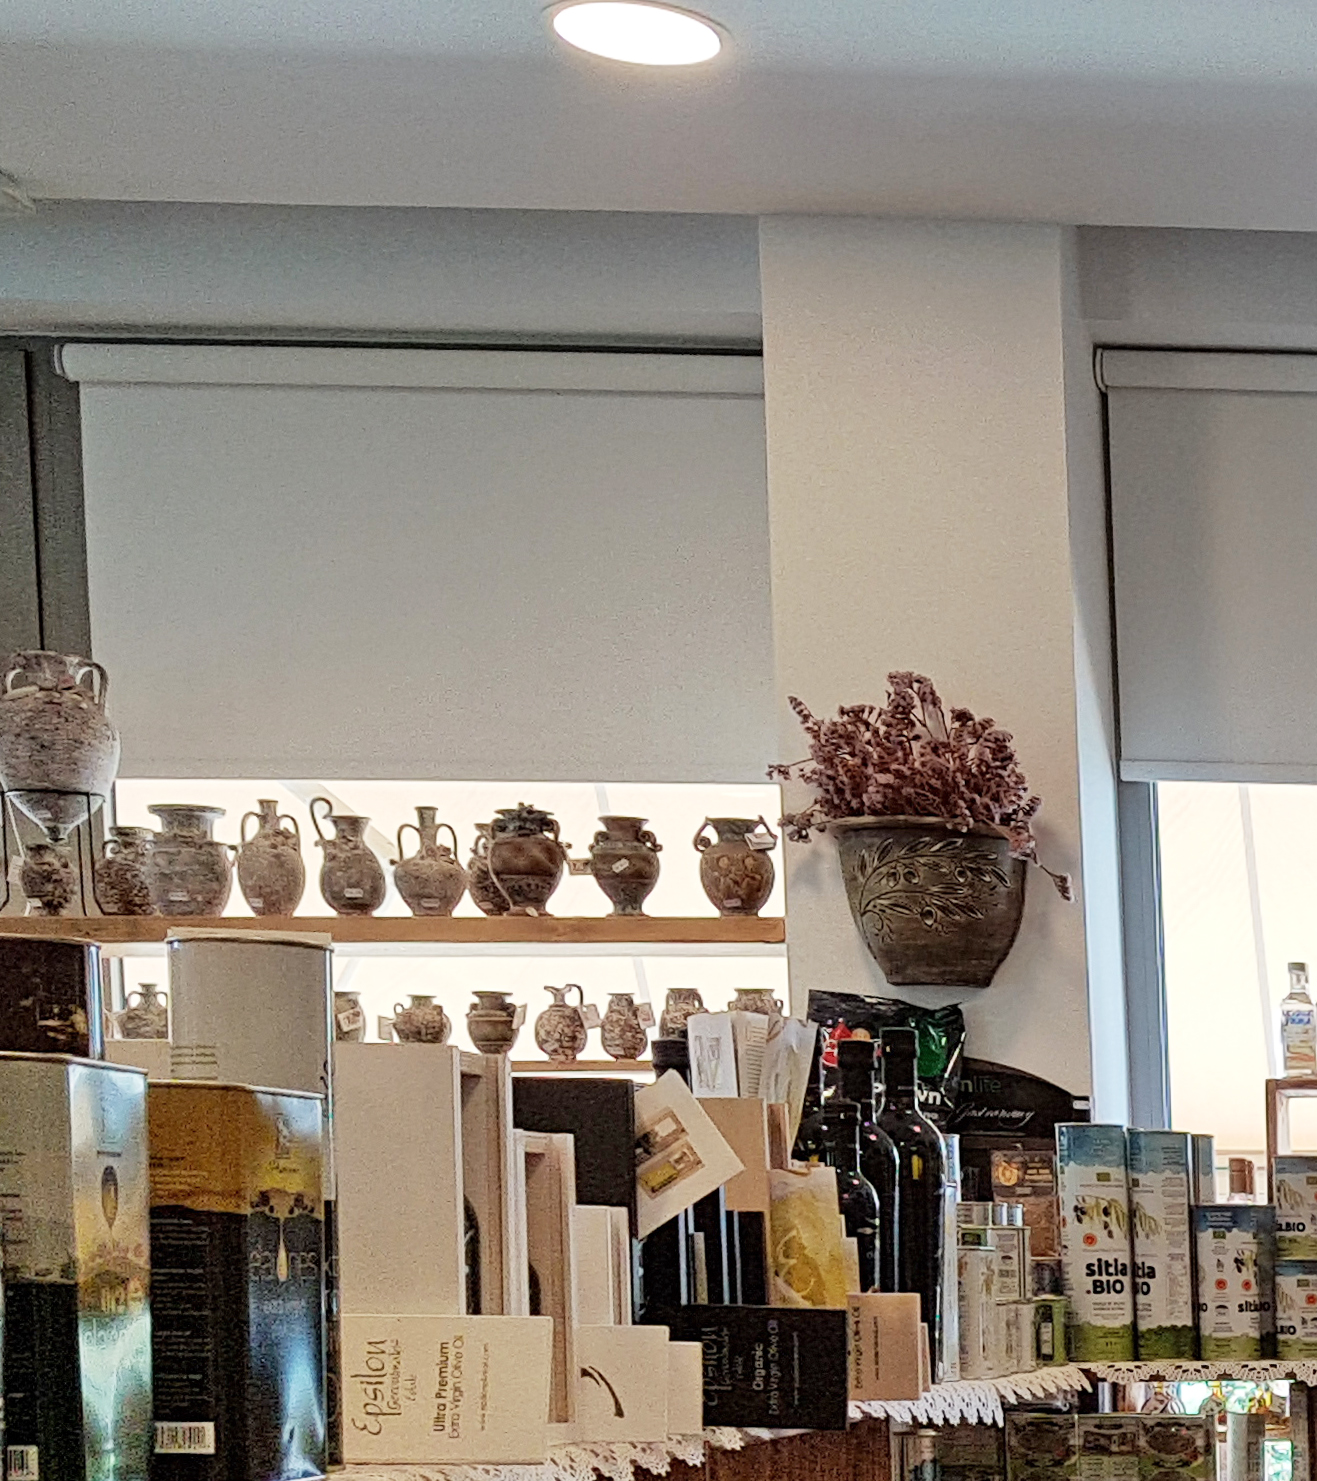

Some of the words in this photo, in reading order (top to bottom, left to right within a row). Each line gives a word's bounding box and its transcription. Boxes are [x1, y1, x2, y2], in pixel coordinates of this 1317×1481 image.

[1085, 1257, 1128, 1278] sitia
[350, 1338, 402, 1436] Epsilon
[434, 1341, 450, 1399] Premium
[751, 1342, 768, 1391] Organic
[433, 1402, 447, 1433] Ultra
